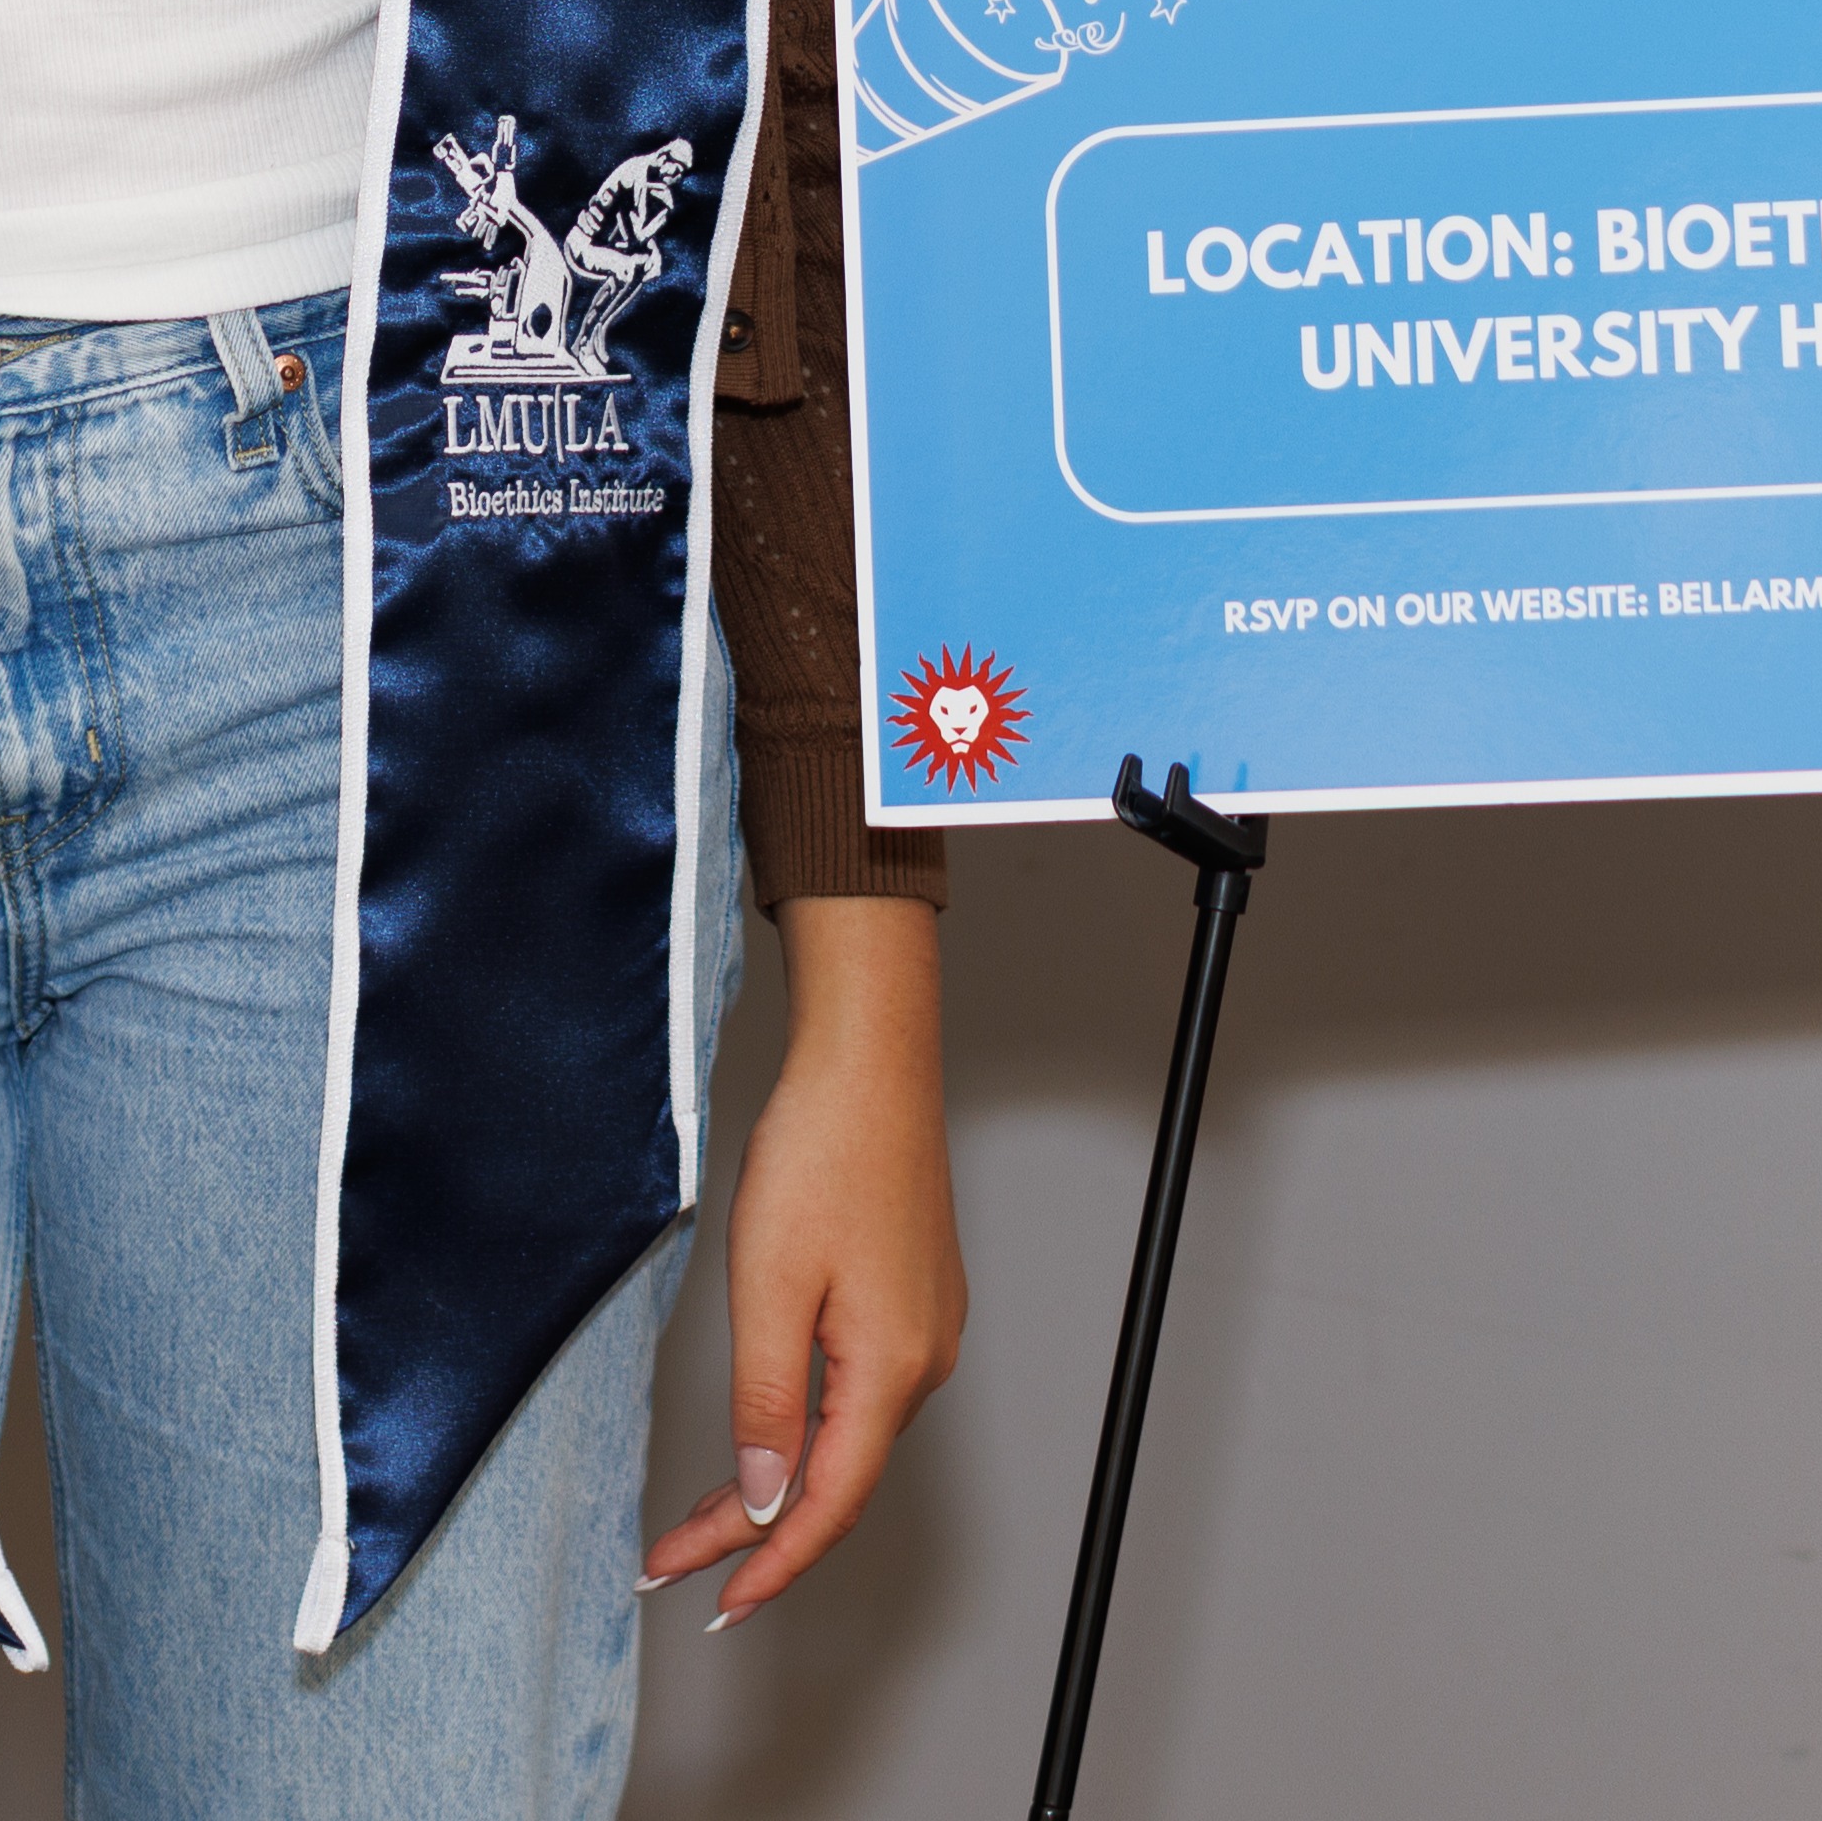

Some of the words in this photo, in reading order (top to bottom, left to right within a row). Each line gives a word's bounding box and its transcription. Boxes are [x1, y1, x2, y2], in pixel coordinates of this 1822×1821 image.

[1146, 208, 1575, 295] LOCATION:
[1300, 309, 1760, 391] UNIVERSITY
[446, 478, 564, 518] Bioethics
[568, 477, 666, 515] Institute
[1223, 597, 1319, 634] RSVP
[1326, 594, 1387, 630] ON
[1394, 590, 1478, 627] OUR
[1480, 582, 1649, 623] WEBSITE:
